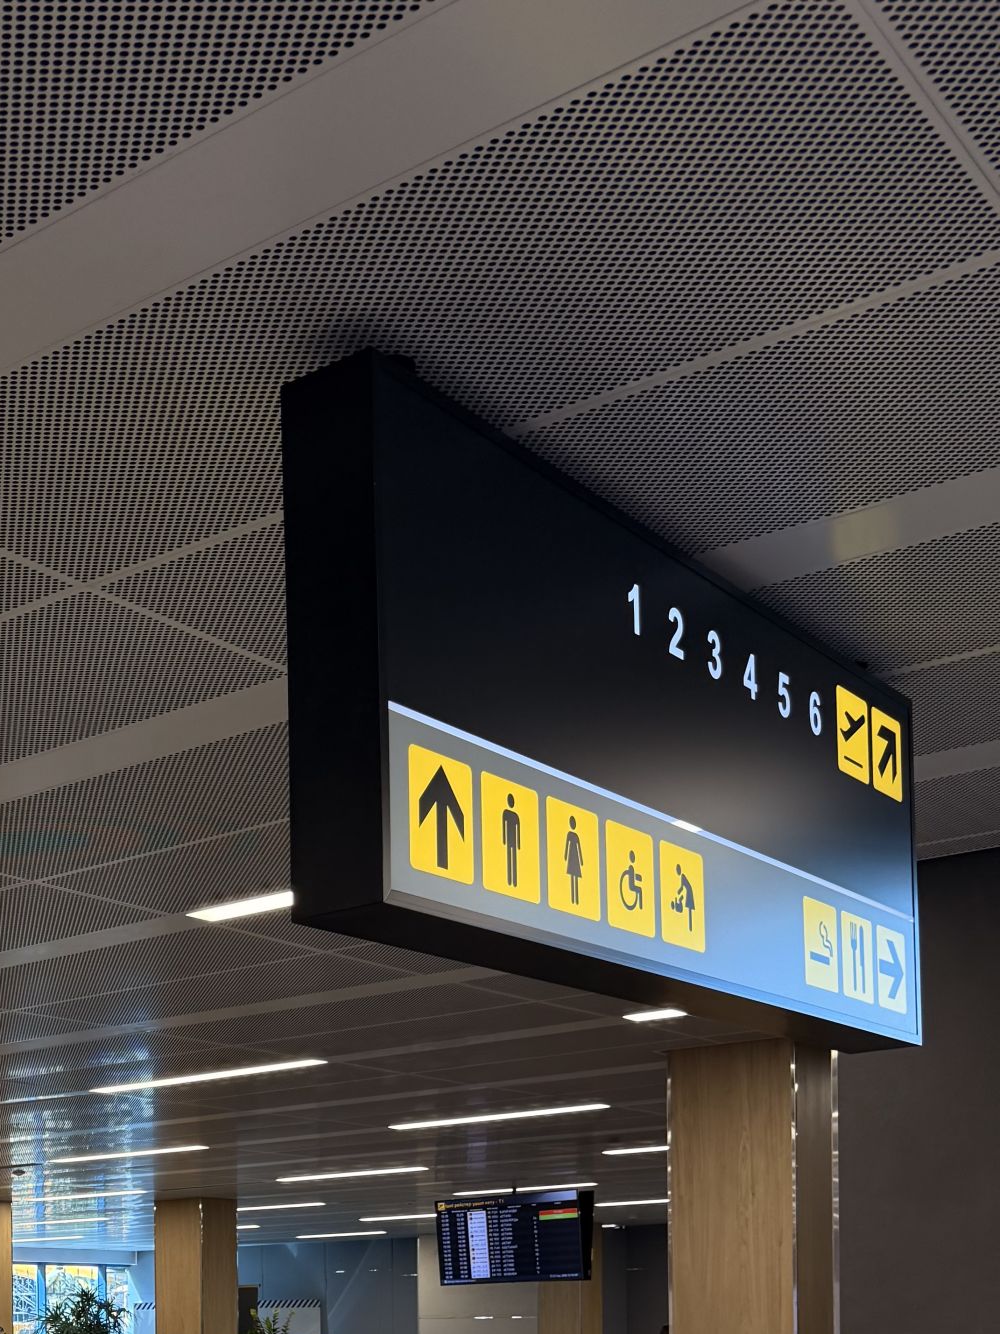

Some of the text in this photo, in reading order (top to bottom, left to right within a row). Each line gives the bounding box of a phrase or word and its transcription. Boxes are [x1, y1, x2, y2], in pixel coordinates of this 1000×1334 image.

[628, 583, 822, 735] 1 2 3 4 5 6
